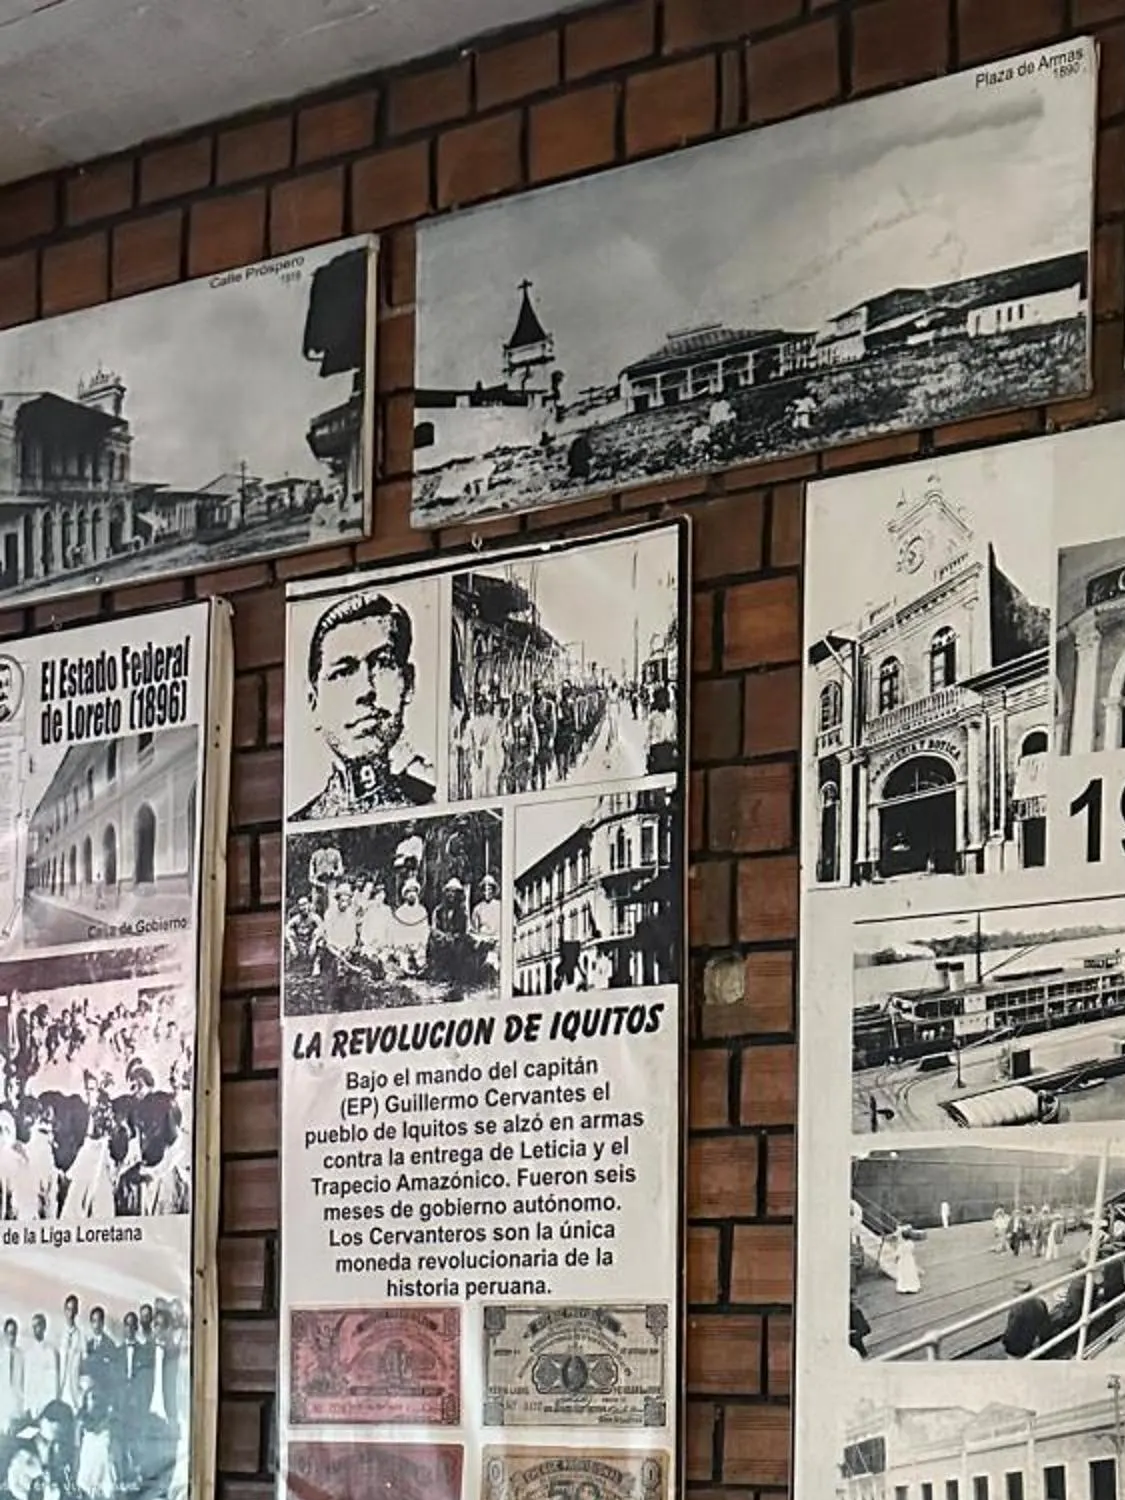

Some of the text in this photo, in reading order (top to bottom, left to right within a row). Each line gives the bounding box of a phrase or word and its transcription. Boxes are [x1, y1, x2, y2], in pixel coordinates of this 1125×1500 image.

[976, 48, 1083, 88] Plaza de Armas
[209, 271, 242, 288] Calle
[41, 635, 190, 702] El Estado Federal
[41, 679, 188, 745] de Loreto (1896)
[135, 917, 187, 933] Gobierno
[293, 1003, 663, 1059] LA REVOLUCION DE IQUITOS
[347, 1057, 598, 1091] Bajo el mando del capitán
[340, 1082, 609, 1119] (EP) Guillermo Cervantes el
[305, 1111, 643, 1148] pueblo de Iquitos se alzó en armas
[323, 1136, 629, 1169] contra la entrega de Leticia y el
[312, 1163, 636, 1197] Trapecio Amazónico. Fueron seis
[324, 1194, 621, 1222] meses de gobierno autónomo.
[3, 1225, 143, 1248] de la Liga Loretana
[329, 1220, 615, 1247] Los Cervanteros son la única
[336, 1248, 613, 1272] moneda revolucionaria de la
[387, 1278, 552, 1300] historia peruana.
